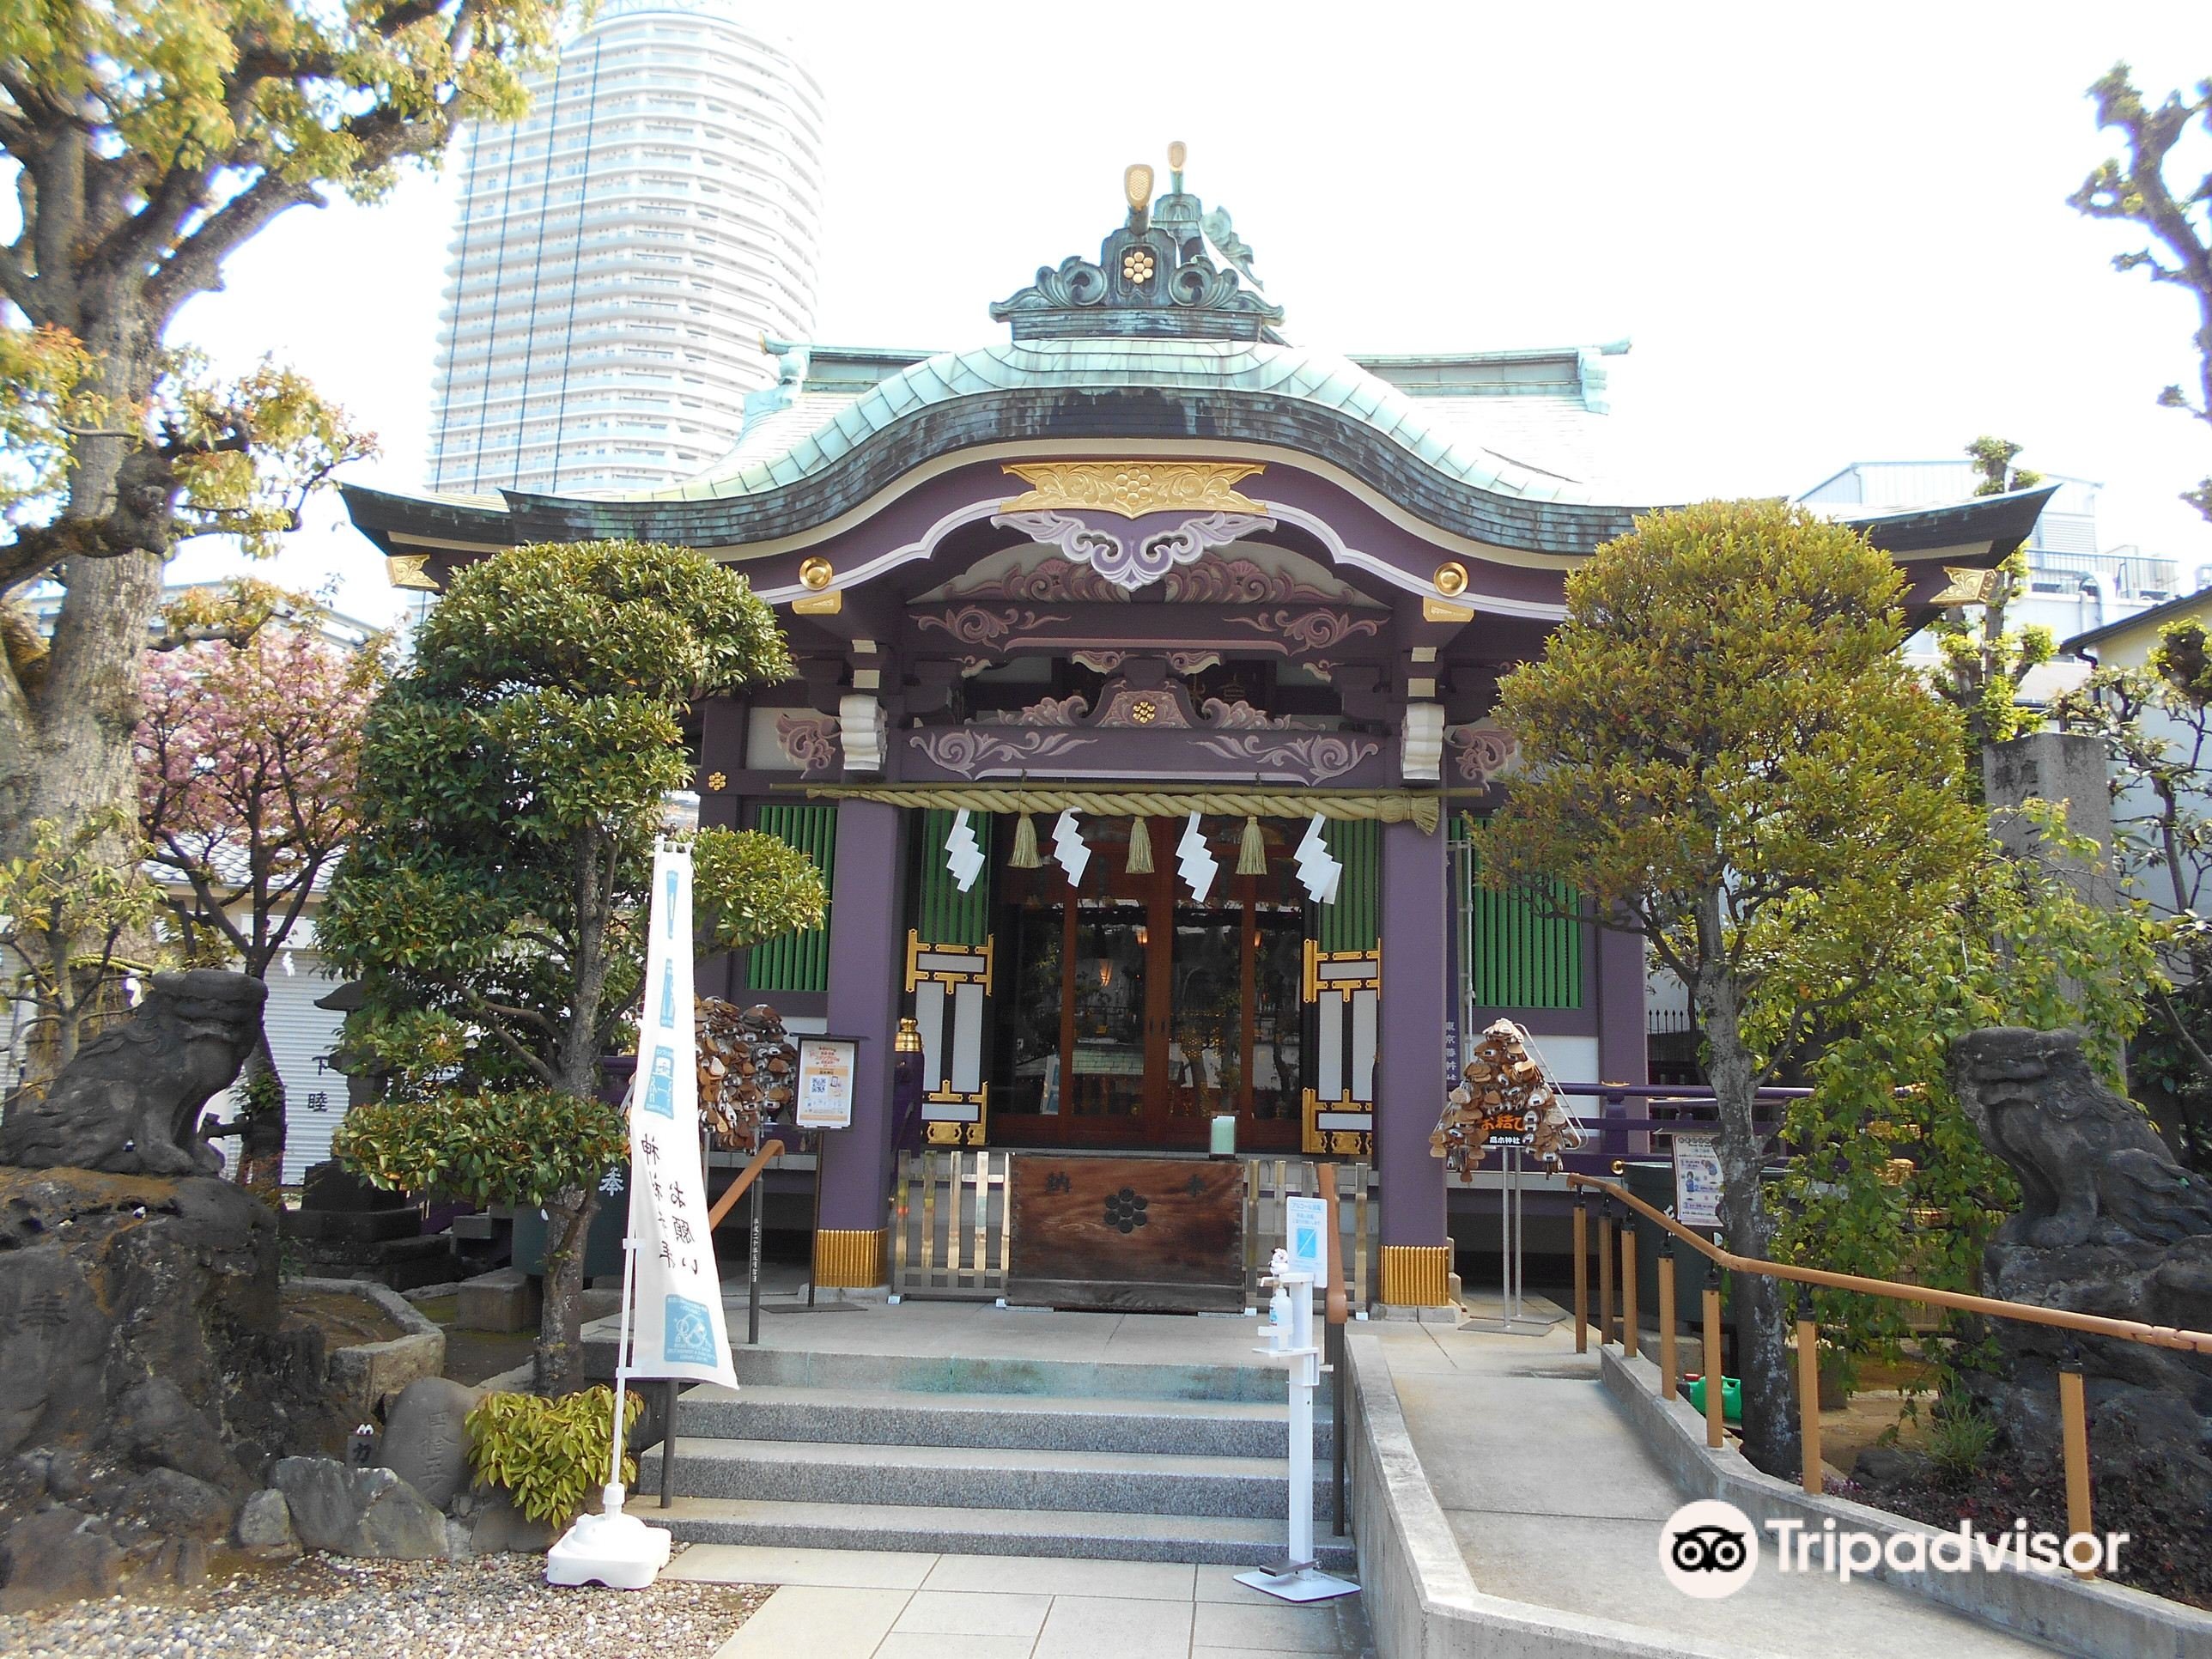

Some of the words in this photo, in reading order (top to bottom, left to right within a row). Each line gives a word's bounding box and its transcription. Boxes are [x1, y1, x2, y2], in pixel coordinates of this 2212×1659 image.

[1489, 1136, 1521, 1145] 高木神社
[599, 1165, 625, 1197] 奉
